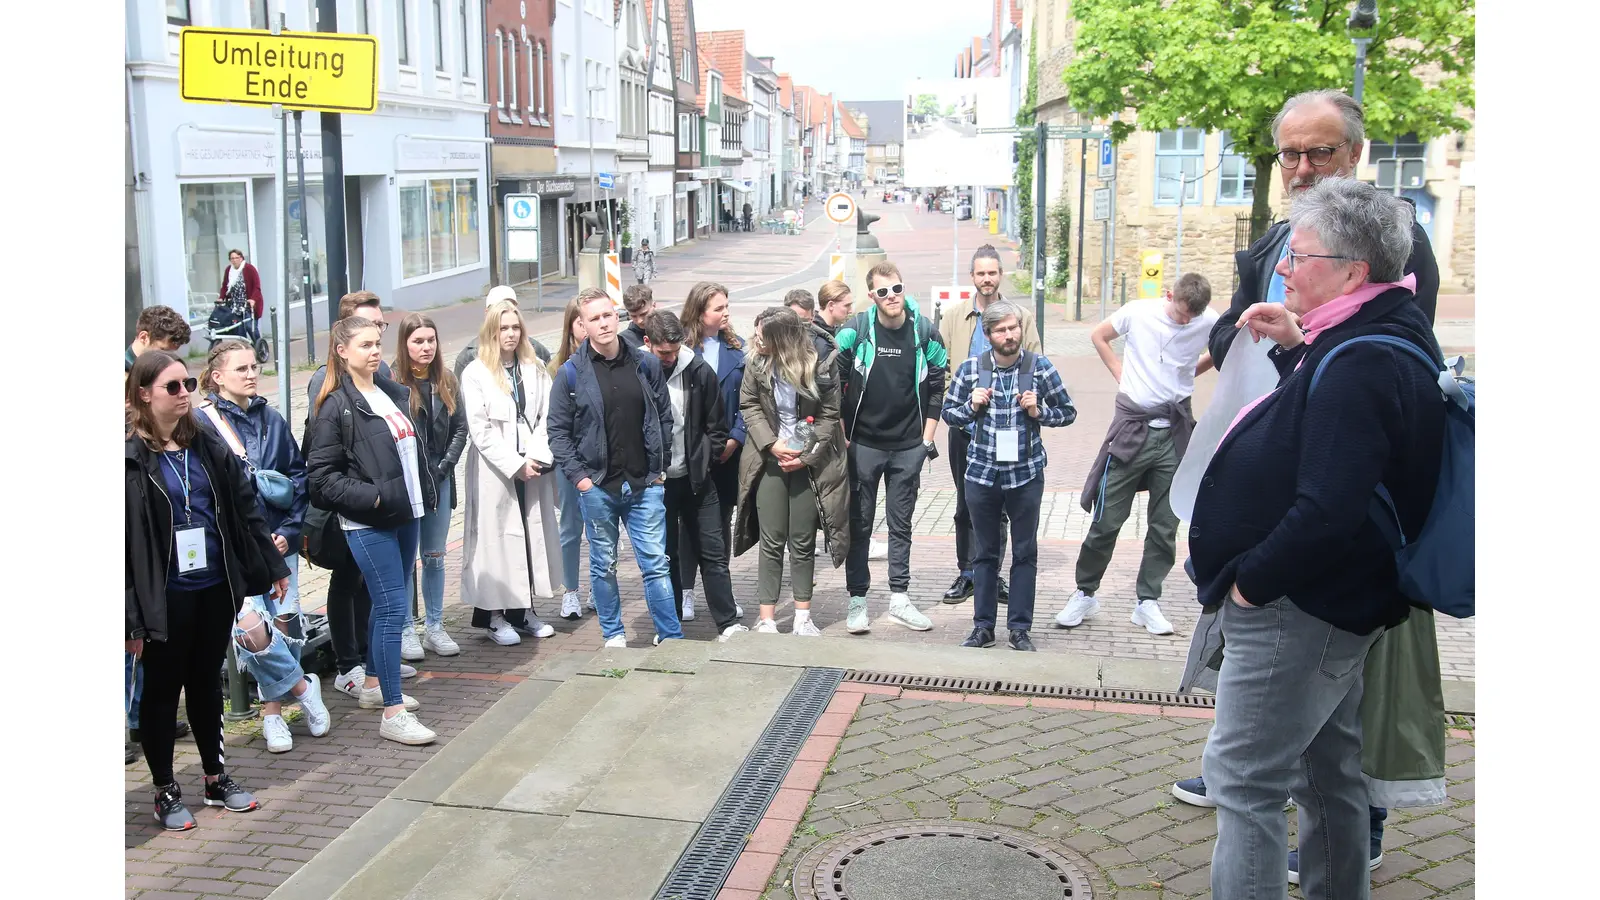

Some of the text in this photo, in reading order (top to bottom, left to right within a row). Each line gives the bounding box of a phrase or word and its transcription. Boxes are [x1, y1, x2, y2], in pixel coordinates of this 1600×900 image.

[212, 39, 345, 79] Umleitung
[245, 70, 308, 99] Ende
[200, 149, 262, 160] GESUNDHEITSPARTNER
[536, 180, 545, 193] Der
[545, 179, 575, 193] Büchsenmacher
[877, 346, 902, 354] HOLLISTER
